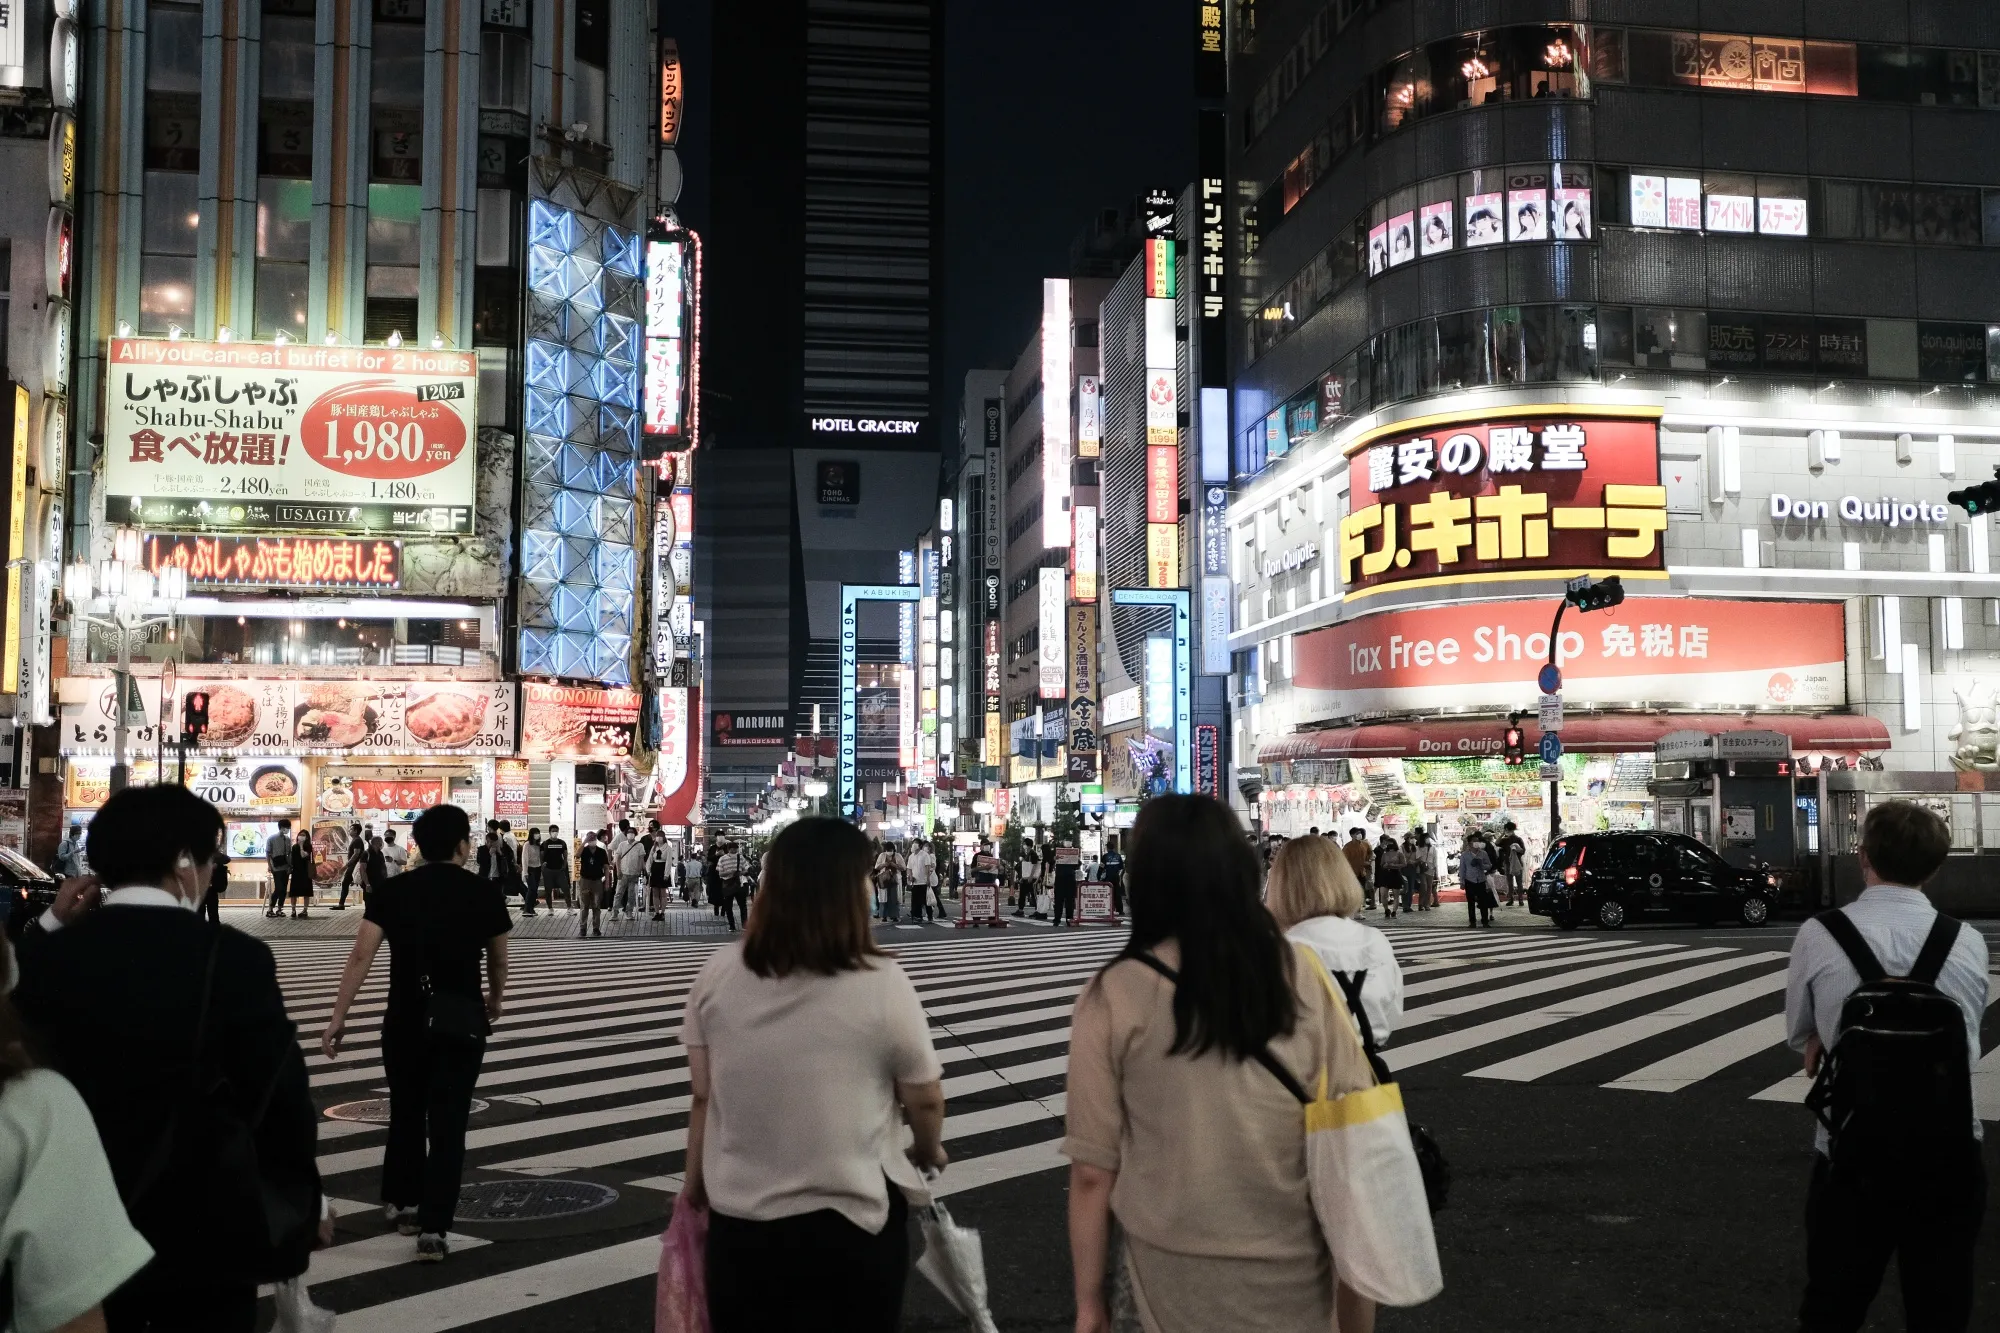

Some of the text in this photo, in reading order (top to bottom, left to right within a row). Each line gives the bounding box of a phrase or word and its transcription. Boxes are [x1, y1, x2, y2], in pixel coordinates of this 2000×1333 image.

[1202, 0, 1221, 51] 殿堂
[1707, 80, 1738, 88] KANKAN
[1510, 174, 1588, 188] OPEN
[1668, 196, 1806, 231] 新宿 アイドル ステージ
[653, 258, 666, 328] イタリアン
[1710, 324, 1863, 351] 販売 ブランド 時計
[119, 342, 471, 373] All-you-can-eat buffet for 2 hours
[125, 373, 299, 407] しゃぶしゃぶ
[421, 384, 461, 401] 120分
[653, 424, 669, 434] 7F
[811, 417, 920, 434] HOTEL GRACERY
[1150, 427, 1175, 435] 生ビール
[128, 427, 291, 466] 食べ放題!
[323, 419, 452, 466] 1,980 yen
[1367, 423, 1588, 493] 驚安の殿堂
[282, 508, 357, 522] USAGIYA
[430, 507, 467, 530] 5F
[1771, 493, 1949, 528] Don Quijote
[1156, 536, 1171, 559] 酒場
[1207, 505, 1219, 572] かんかん商店
[150, 536, 394, 583] しゃぶしゃぶも始めました
[1264, 541, 1316, 578] Don Quijote
[660, 572, 669, 608] とらそば
[986, 574, 999, 610] Booth
[1075, 610, 1089, 679] きんくら酒場
[1349, 623, 1710, 676] Tax Free Shop 免税店
[19, 657, 30, 699] とらそば
[986, 652, 1000, 692] 甘太郎
[1804, 674, 1829, 683] Japan.
[262, 684, 273, 708] そば
[530, 688, 641, 707] OKONOMI YAKI
[843, 618, 855, 784] GODZILLA ROAD
[1043, 687, 1062, 698] B1
[1803, 684, 1829, 692] Tax-free
[1811, 692, 1830, 701] Shop
[275, 683, 289, 730] かき揚げ
[376, 686, 386, 731] ラーメン
[390, 685, 402, 733] とんこつ
[493, 684, 510, 731] かつ丼
[987, 704, 1000, 712] 3F
[1178, 636, 1189, 773] ゴジラロード
[75, 723, 159, 743] とらば
[736, 716, 784, 729] MARUHAN
[1070, 695, 1097, 752] 金の蔵
[252, 733, 290, 747] 500円
[364, 733, 401, 747] 500円
[475, 733, 511, 748] 550円
[987, 726, 999, 767] やきとり
[1418, 738, 1508, 755] Don Quijo
[1722, 738, 1784, 747] 安全安心ステーション
[396, 768, 424, 776] とらそば
[1071, 756, 1088, 771] 2F
[1200, 730, 1214, 794] カラオケ
[195, 786, 246, 803] 700円
[357, 788, 441, 805] とらそば
